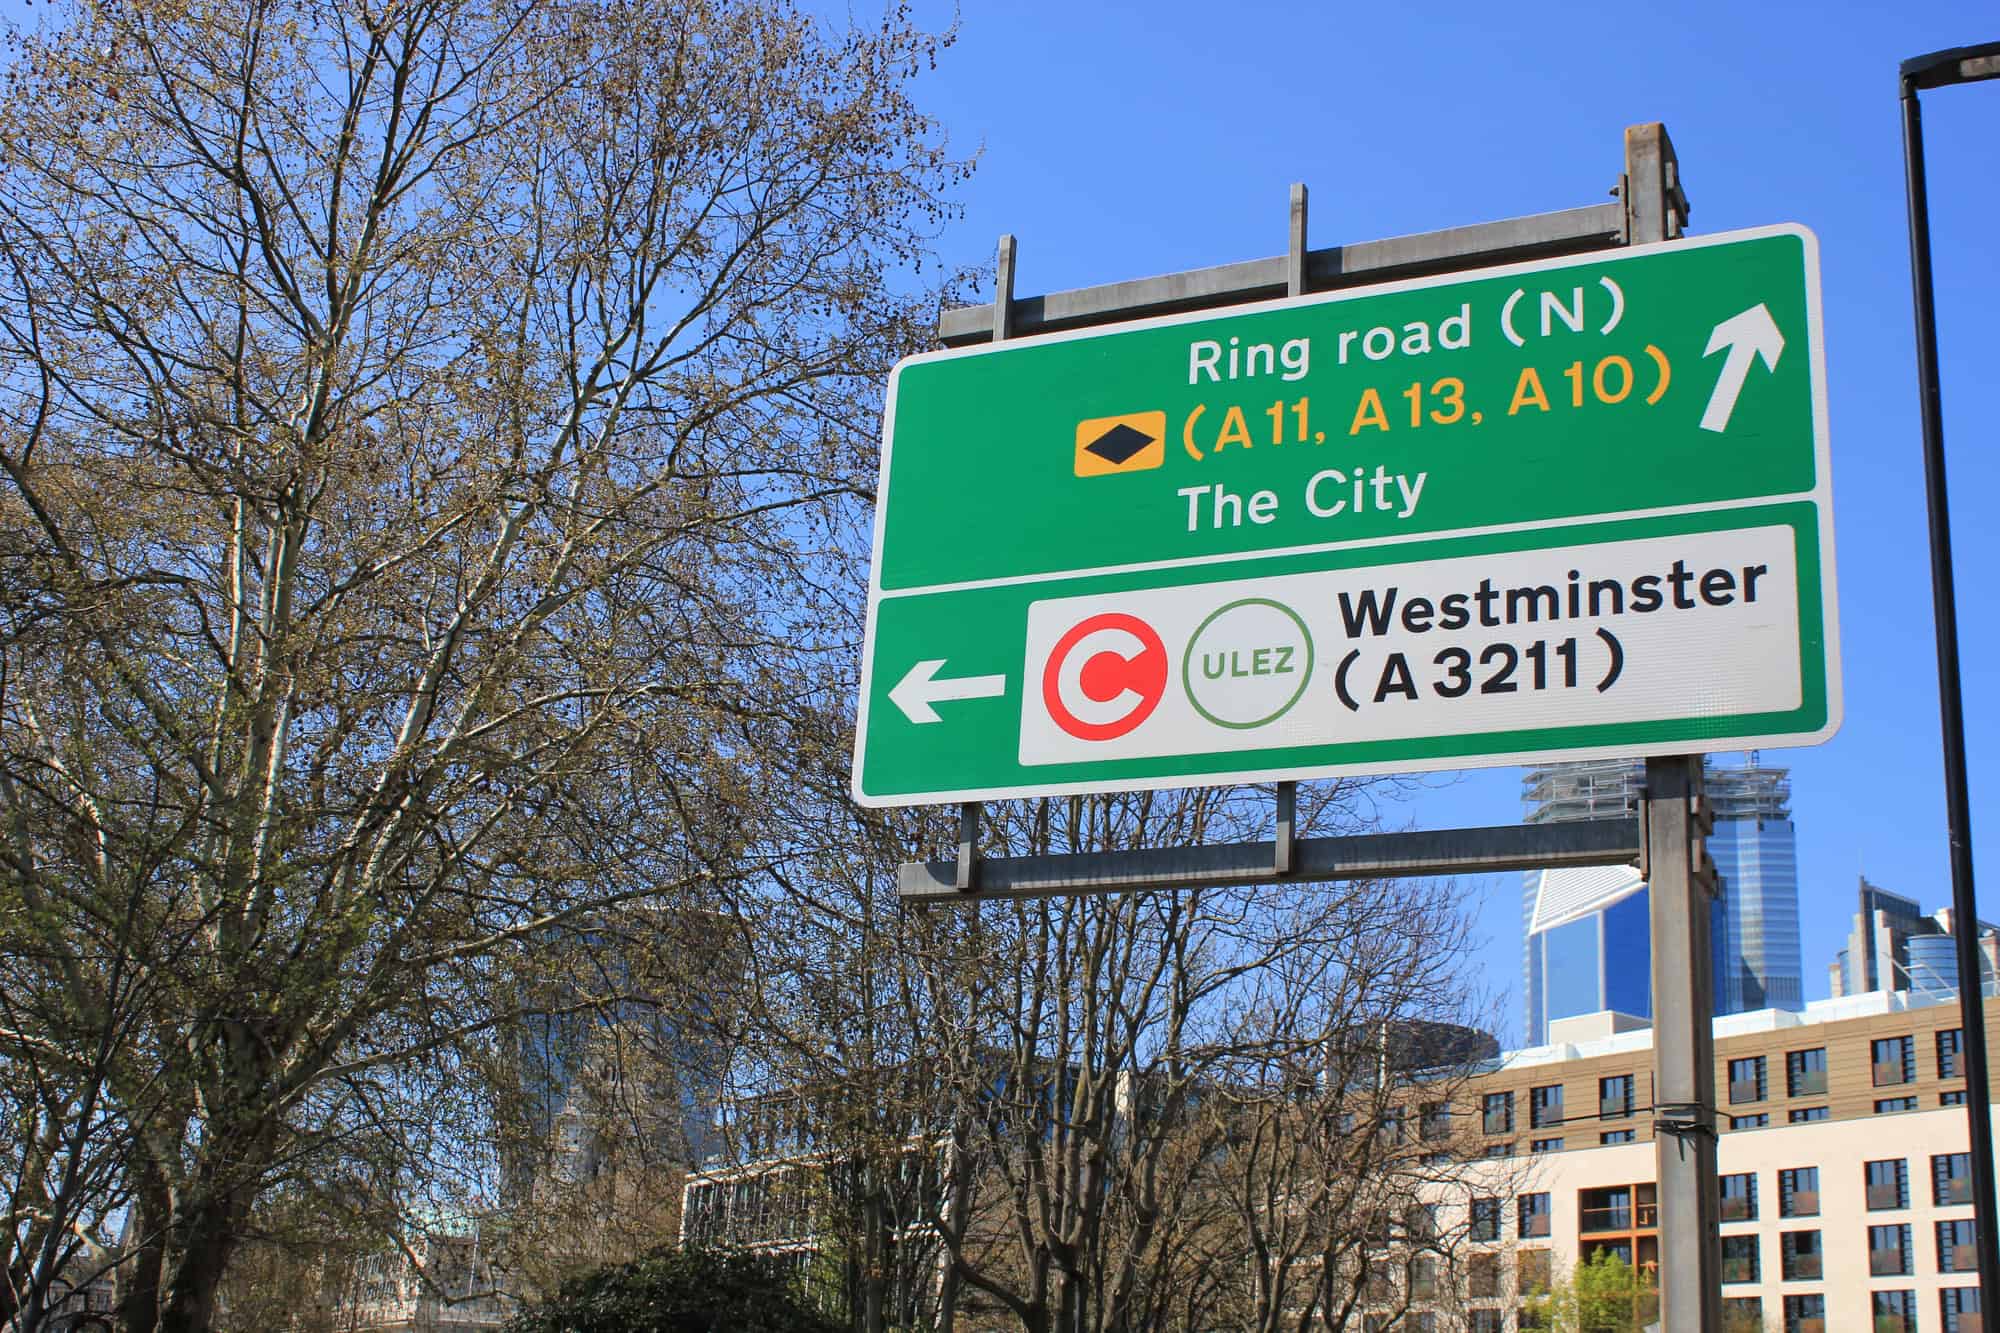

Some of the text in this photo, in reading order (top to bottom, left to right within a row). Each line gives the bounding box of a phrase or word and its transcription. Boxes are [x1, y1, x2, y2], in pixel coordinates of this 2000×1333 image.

[1190, 277, 1625, 384] Ring road (N)
[1178, 466, 1427, 532] The City
[1337, 560, 1768, 639] Westminster
[1203, 646, 1296, 681] ULEZ
